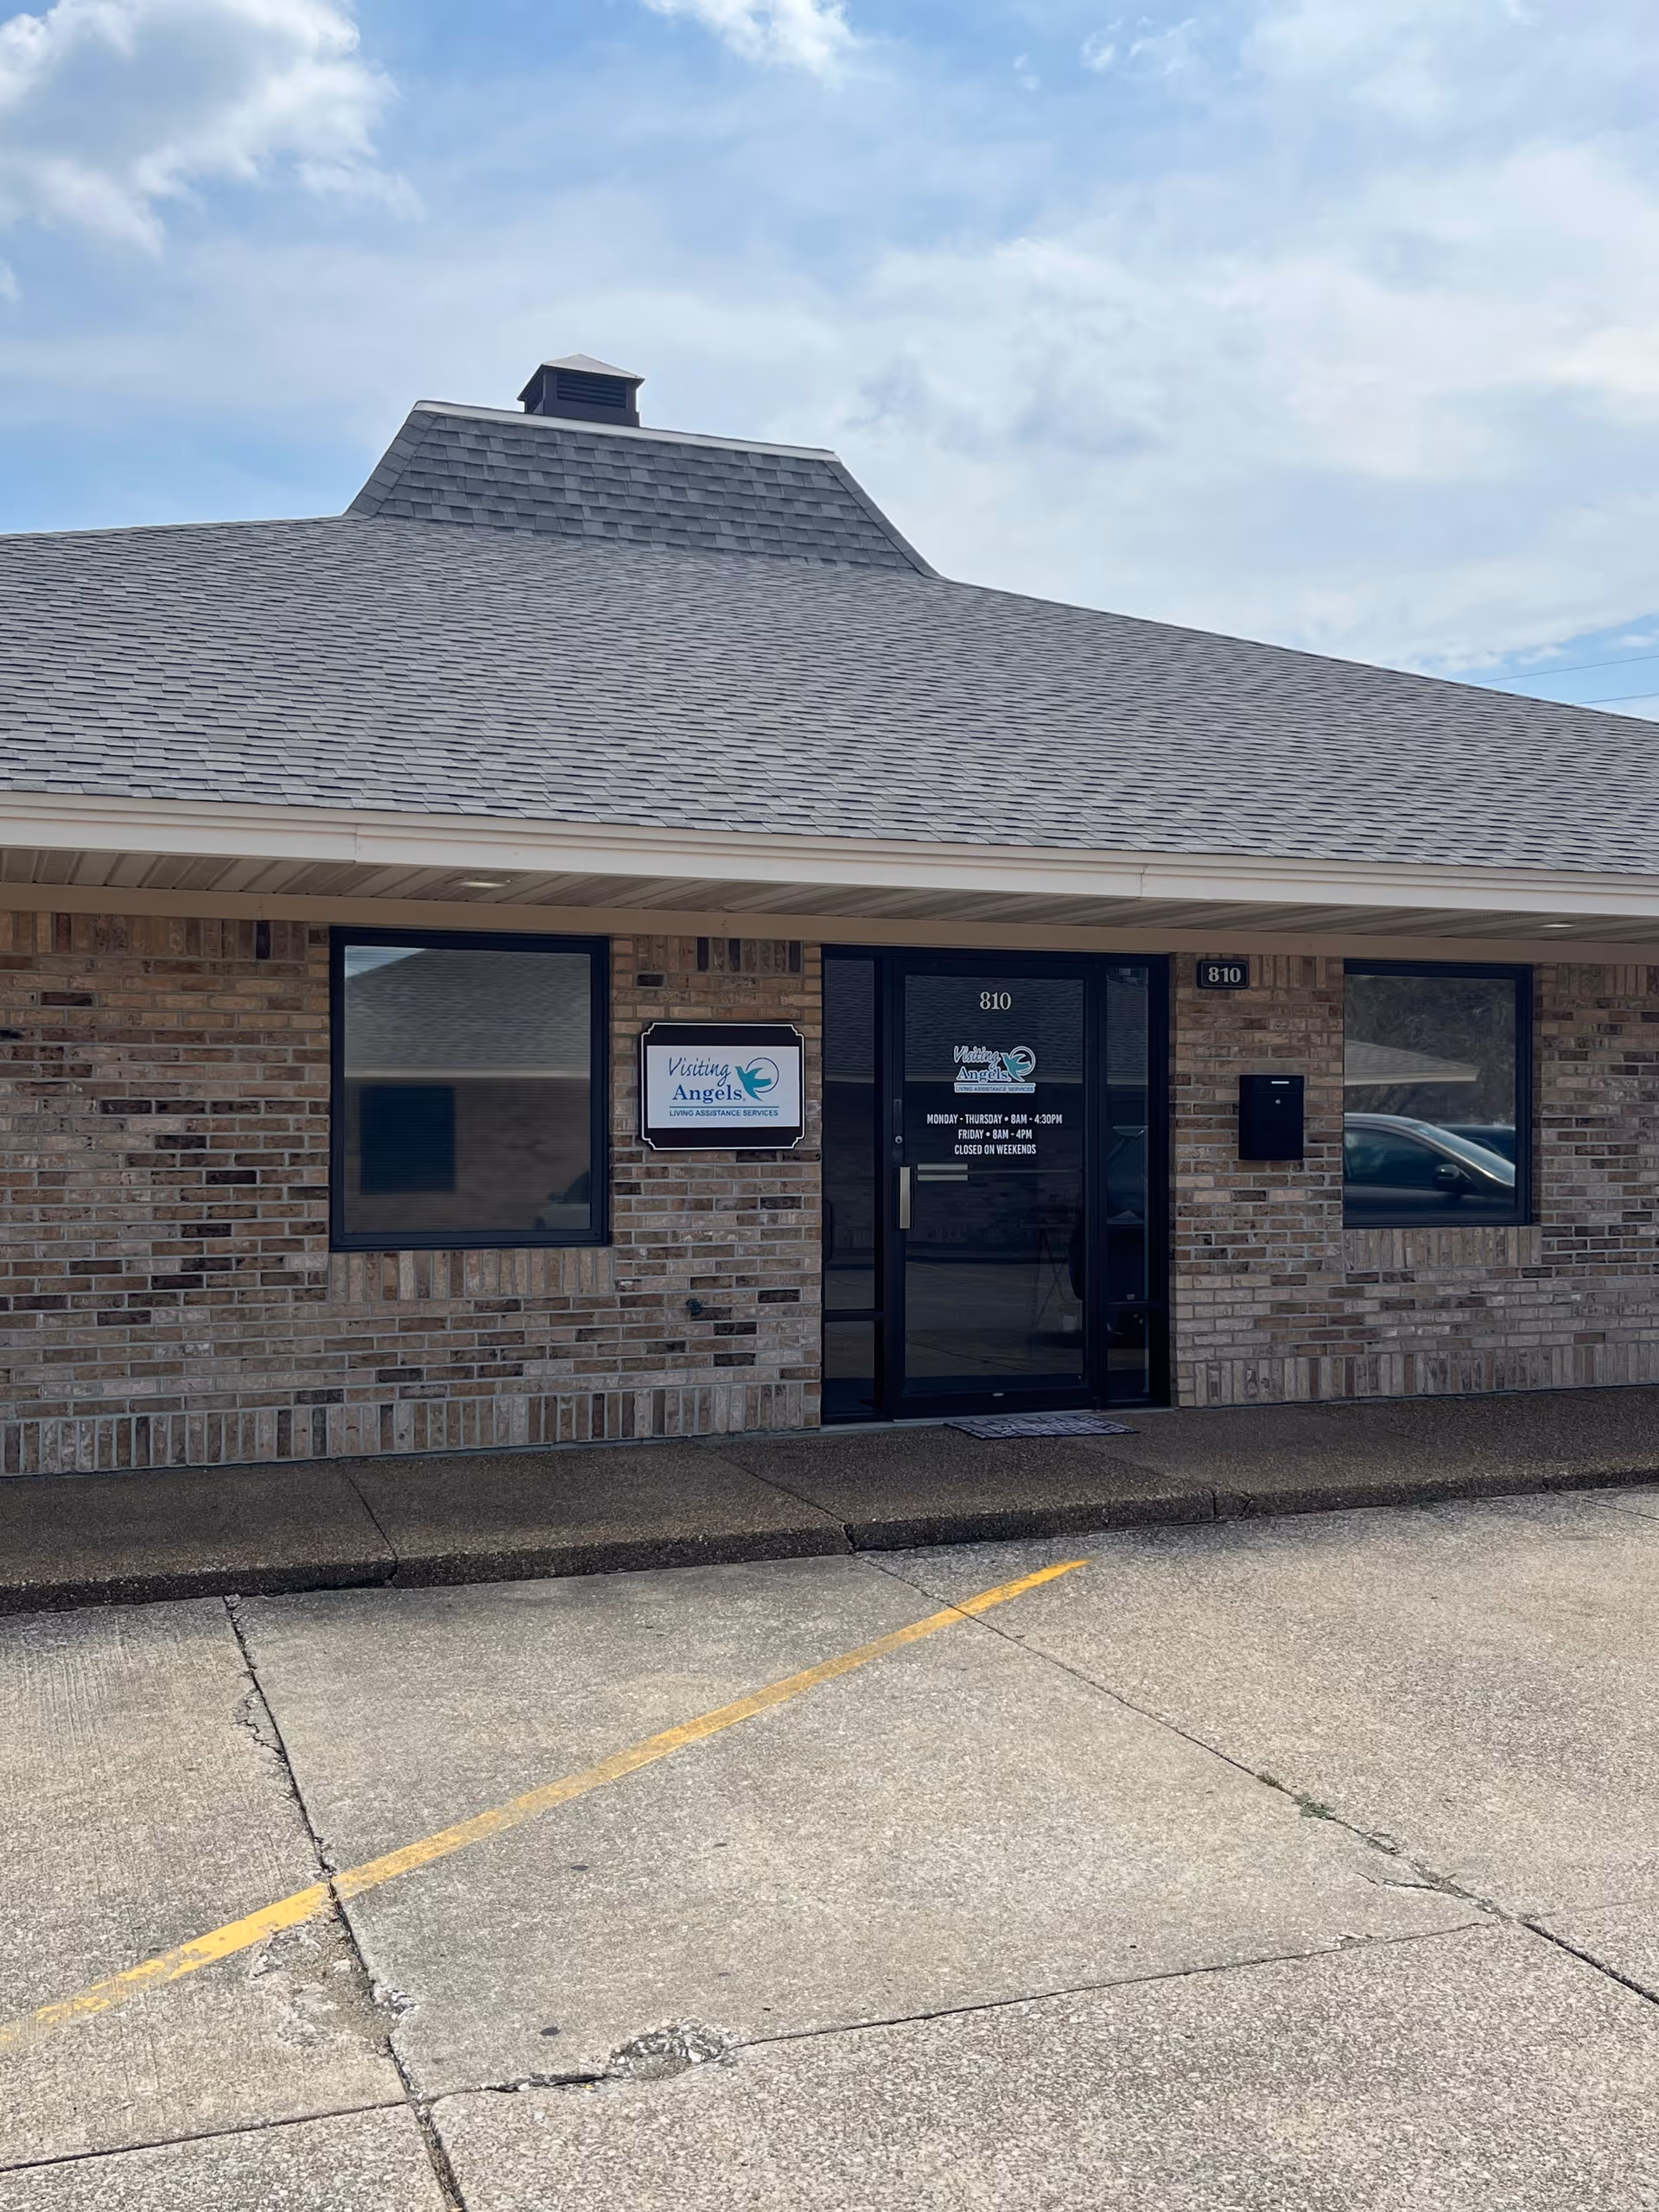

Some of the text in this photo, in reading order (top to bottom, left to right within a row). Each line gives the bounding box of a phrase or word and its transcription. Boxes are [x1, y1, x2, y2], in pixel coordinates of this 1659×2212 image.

[1208, 967, 1241, 983] 810
[979, 991, 1012, 1010] 810
[953, 1046, 1001, 1069] Visiting
[669, 1057, 732, 1087] Visiting
[957, 1066, 1008, 1083] Angels
[672, 1084, 742, 1103] Angels
[926, 1114, 958, 1125] MONDAY
[965, 1114, 1002, 1124] THURSDAY
[1010, 1114, 1027, 1124] 8AM
[1034, 1114, 1063, 1124] 4:30PM
[957, 1129, 984, 1140] FRIDAY
[992, 1129, 1009, 1140] 8AM
[1015, 1129, 1033, 1140] 4PM
[954, 1144, 1037, 1154] CLOSED ON WEEKENDS
